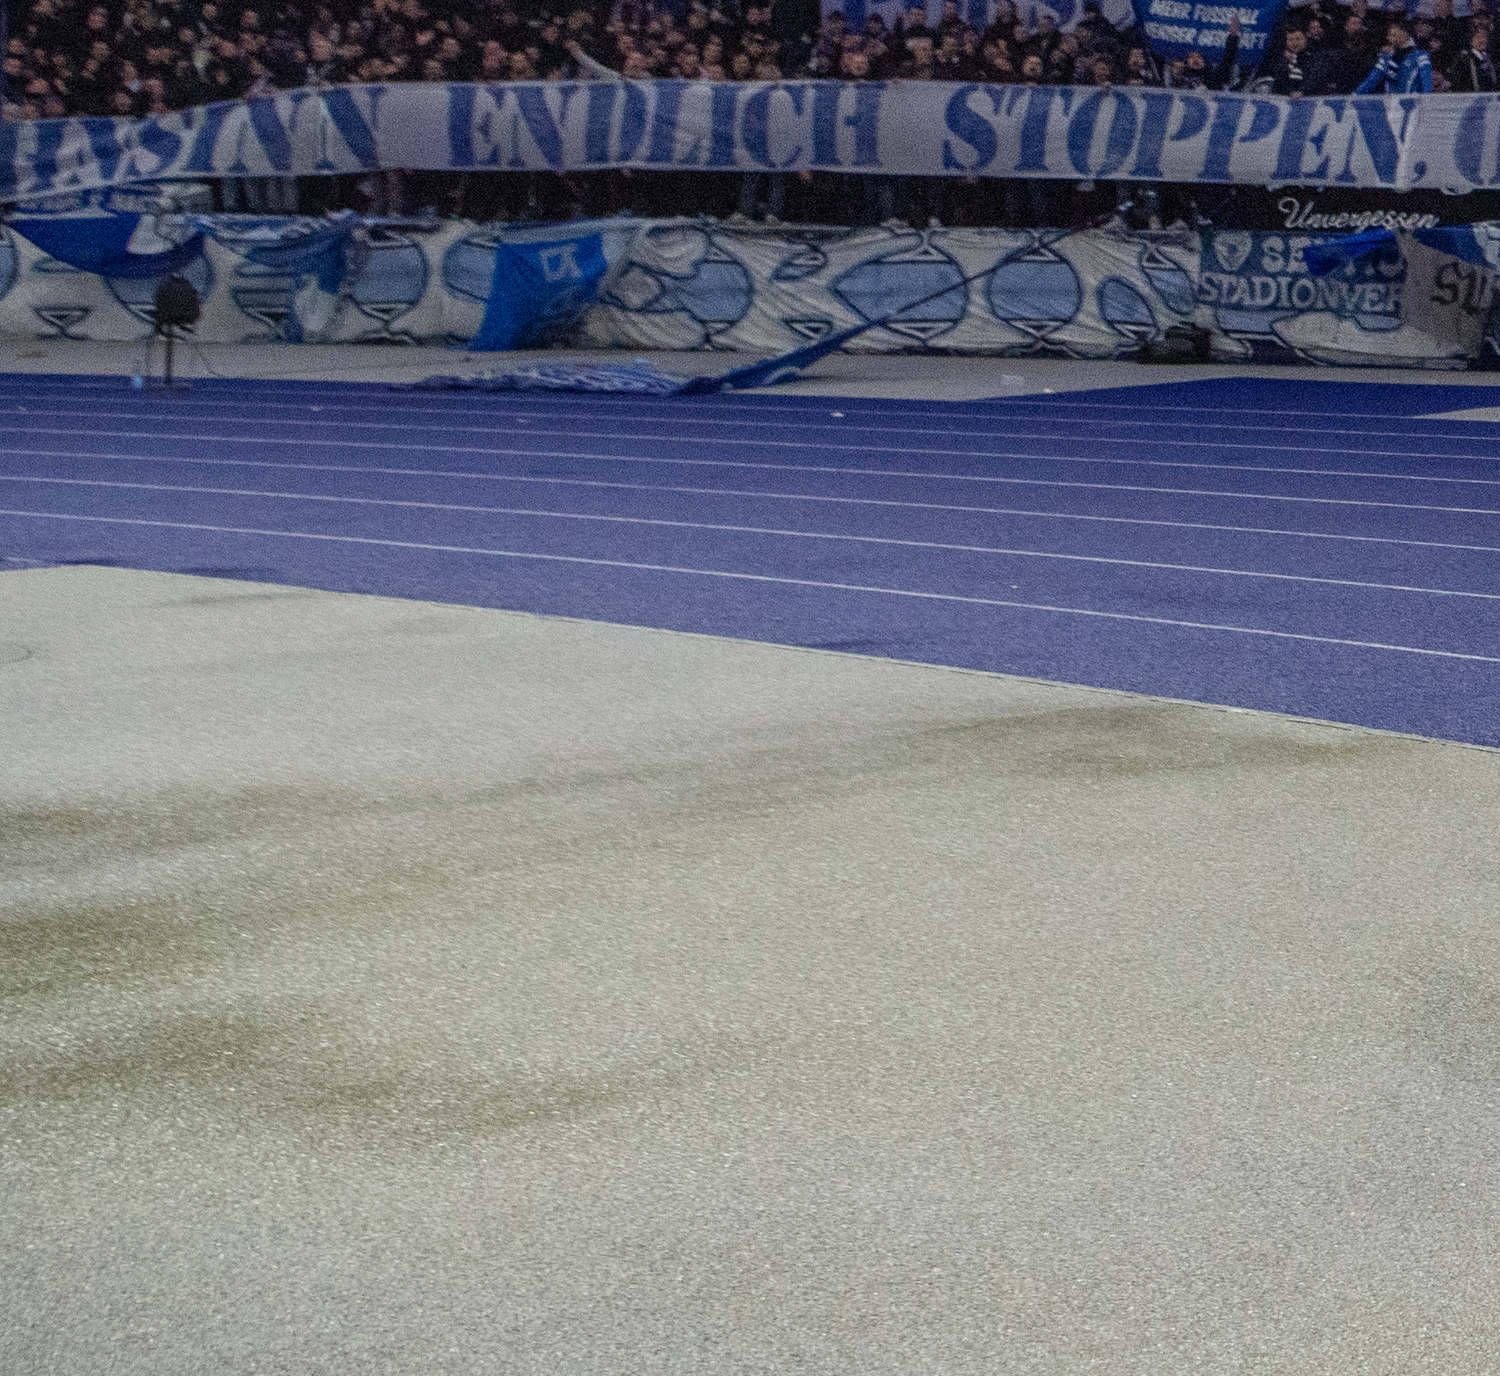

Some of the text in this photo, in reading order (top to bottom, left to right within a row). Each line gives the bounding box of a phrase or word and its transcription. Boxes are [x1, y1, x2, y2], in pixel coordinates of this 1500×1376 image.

[446, 81, 888, 171] ENDLICH
[941, 86, 1427, 188] STOPPEN,
[1278, 195, 1440, 231] Unvergessen
